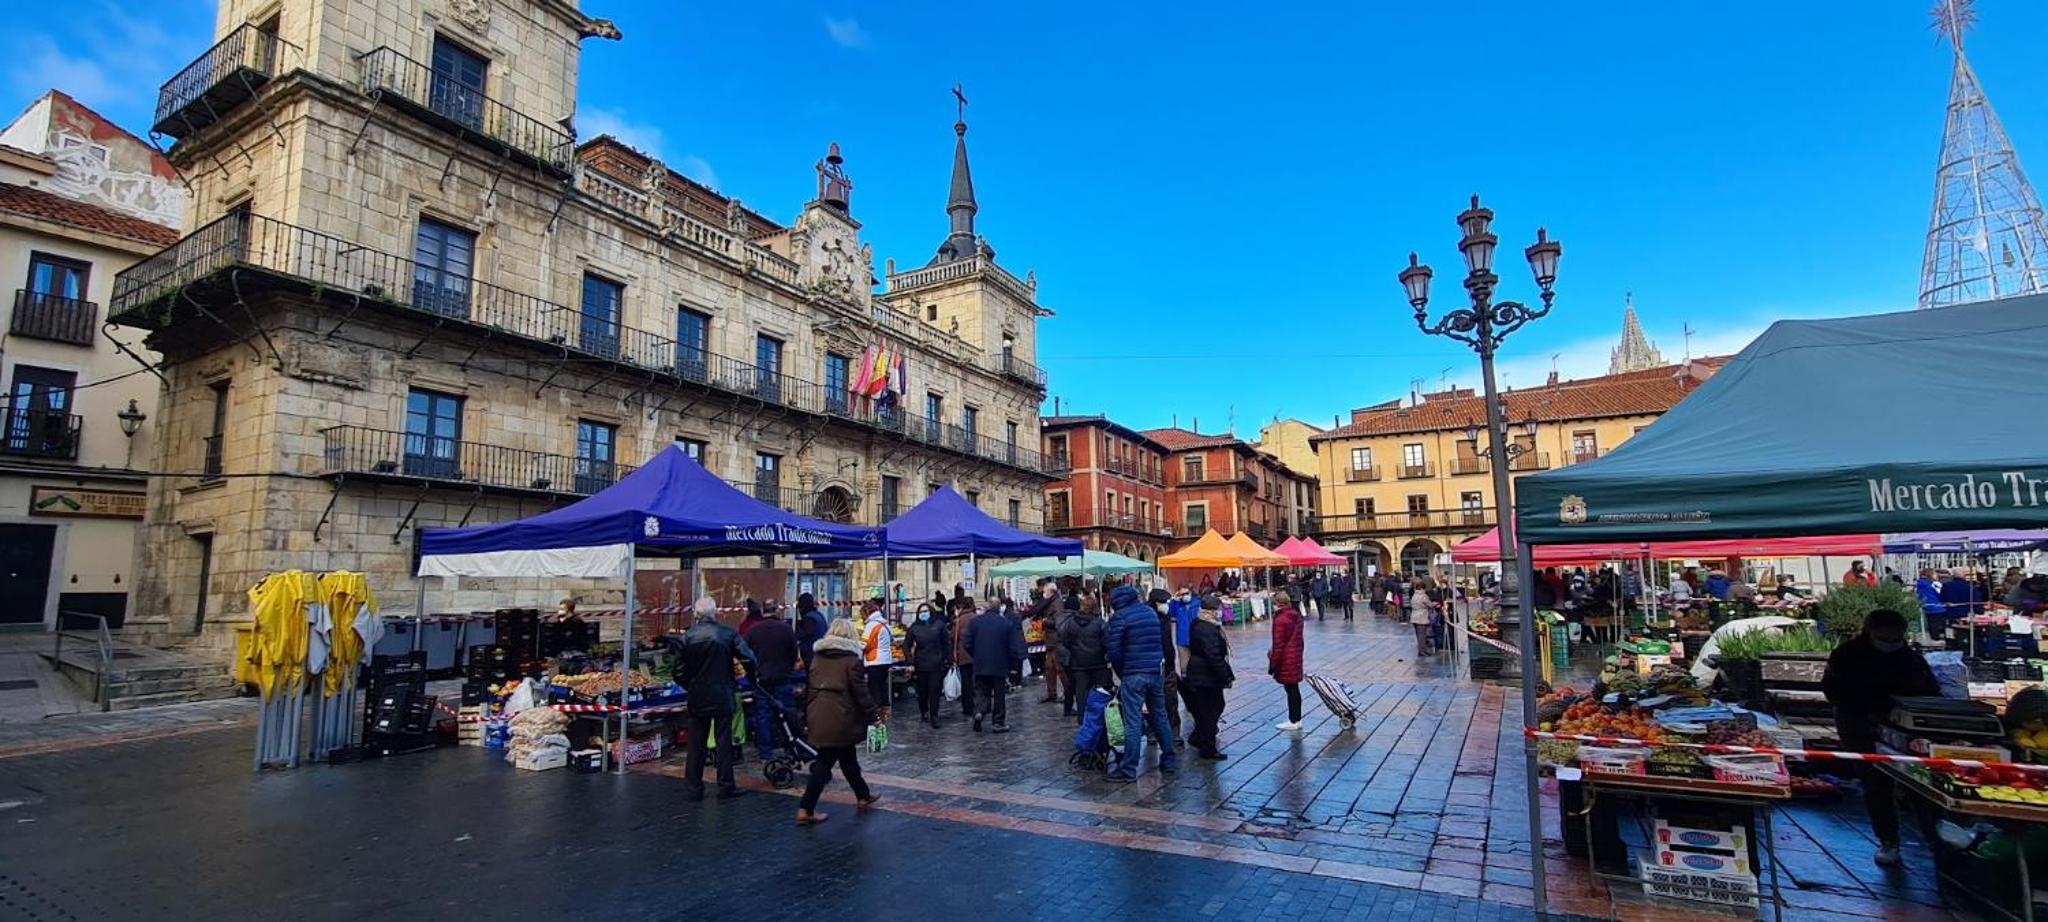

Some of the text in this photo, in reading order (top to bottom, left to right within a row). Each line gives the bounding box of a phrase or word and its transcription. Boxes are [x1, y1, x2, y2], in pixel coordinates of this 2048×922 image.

[1867, 471, 2048, 512] Mercado Tr
[724, 524, 775, 541] Mercado
